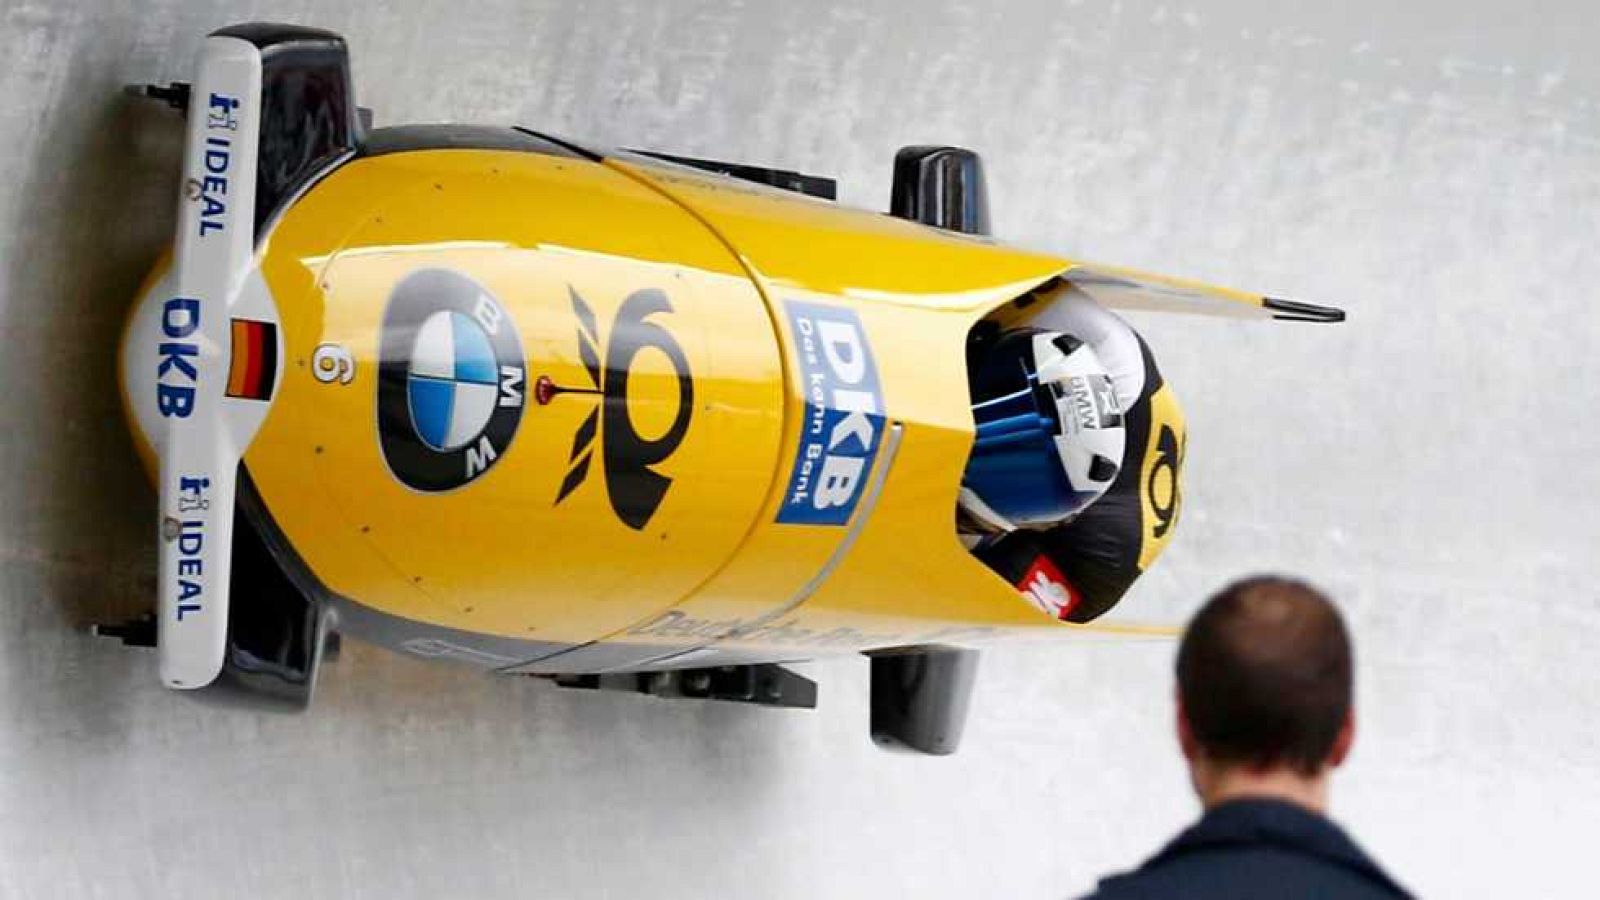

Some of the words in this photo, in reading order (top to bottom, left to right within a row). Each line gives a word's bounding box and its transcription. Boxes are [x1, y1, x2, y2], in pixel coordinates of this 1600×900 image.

[200, 137, 231, 237] IDEAL
[157, 298, 200, 417] DKB
[312, 344, 354, 385] 6
[465, 293, 524, 479] BMW
[796, 316, 818, 367] Das
[810, 372, 826, 434] kann
[812, 320, 875, 509] DKB
[792, 444, 823, 504] Bank
[177, 521, 205, 621] IDEAL
